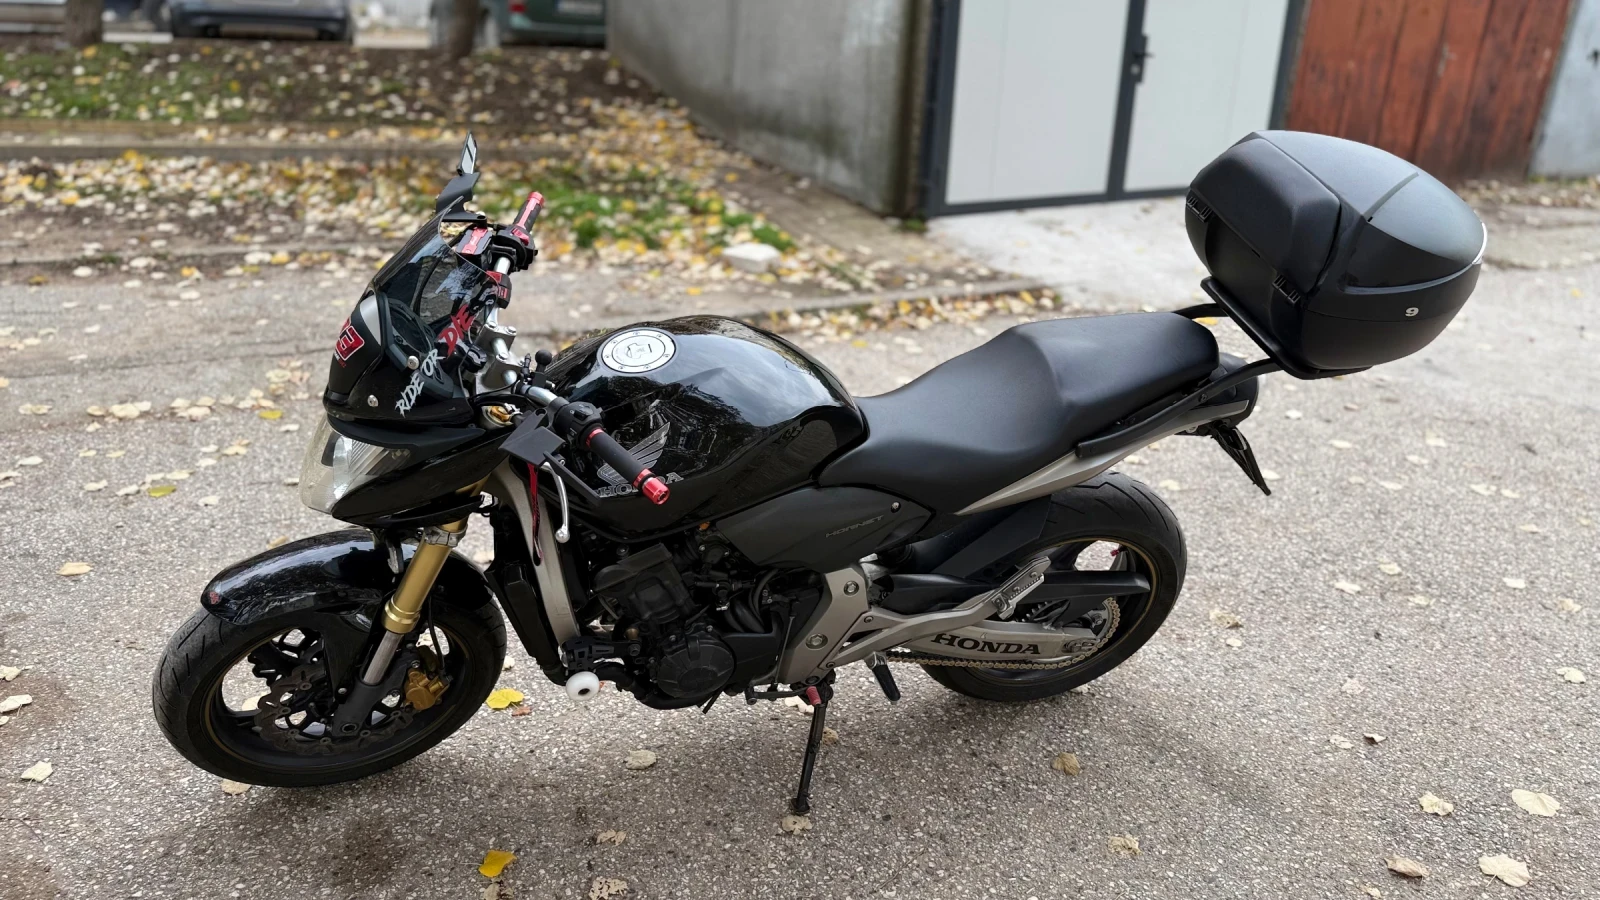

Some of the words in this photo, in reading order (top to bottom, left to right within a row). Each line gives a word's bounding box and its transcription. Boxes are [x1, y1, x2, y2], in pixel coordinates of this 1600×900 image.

[395, 372, 424, 418] RIDE
[420, 348, 446, 376] OR
[438, 304, 475, 359] DIE
[595, 472, 684, 498] HOA
[931, 633, 1041, 655] HONDA
